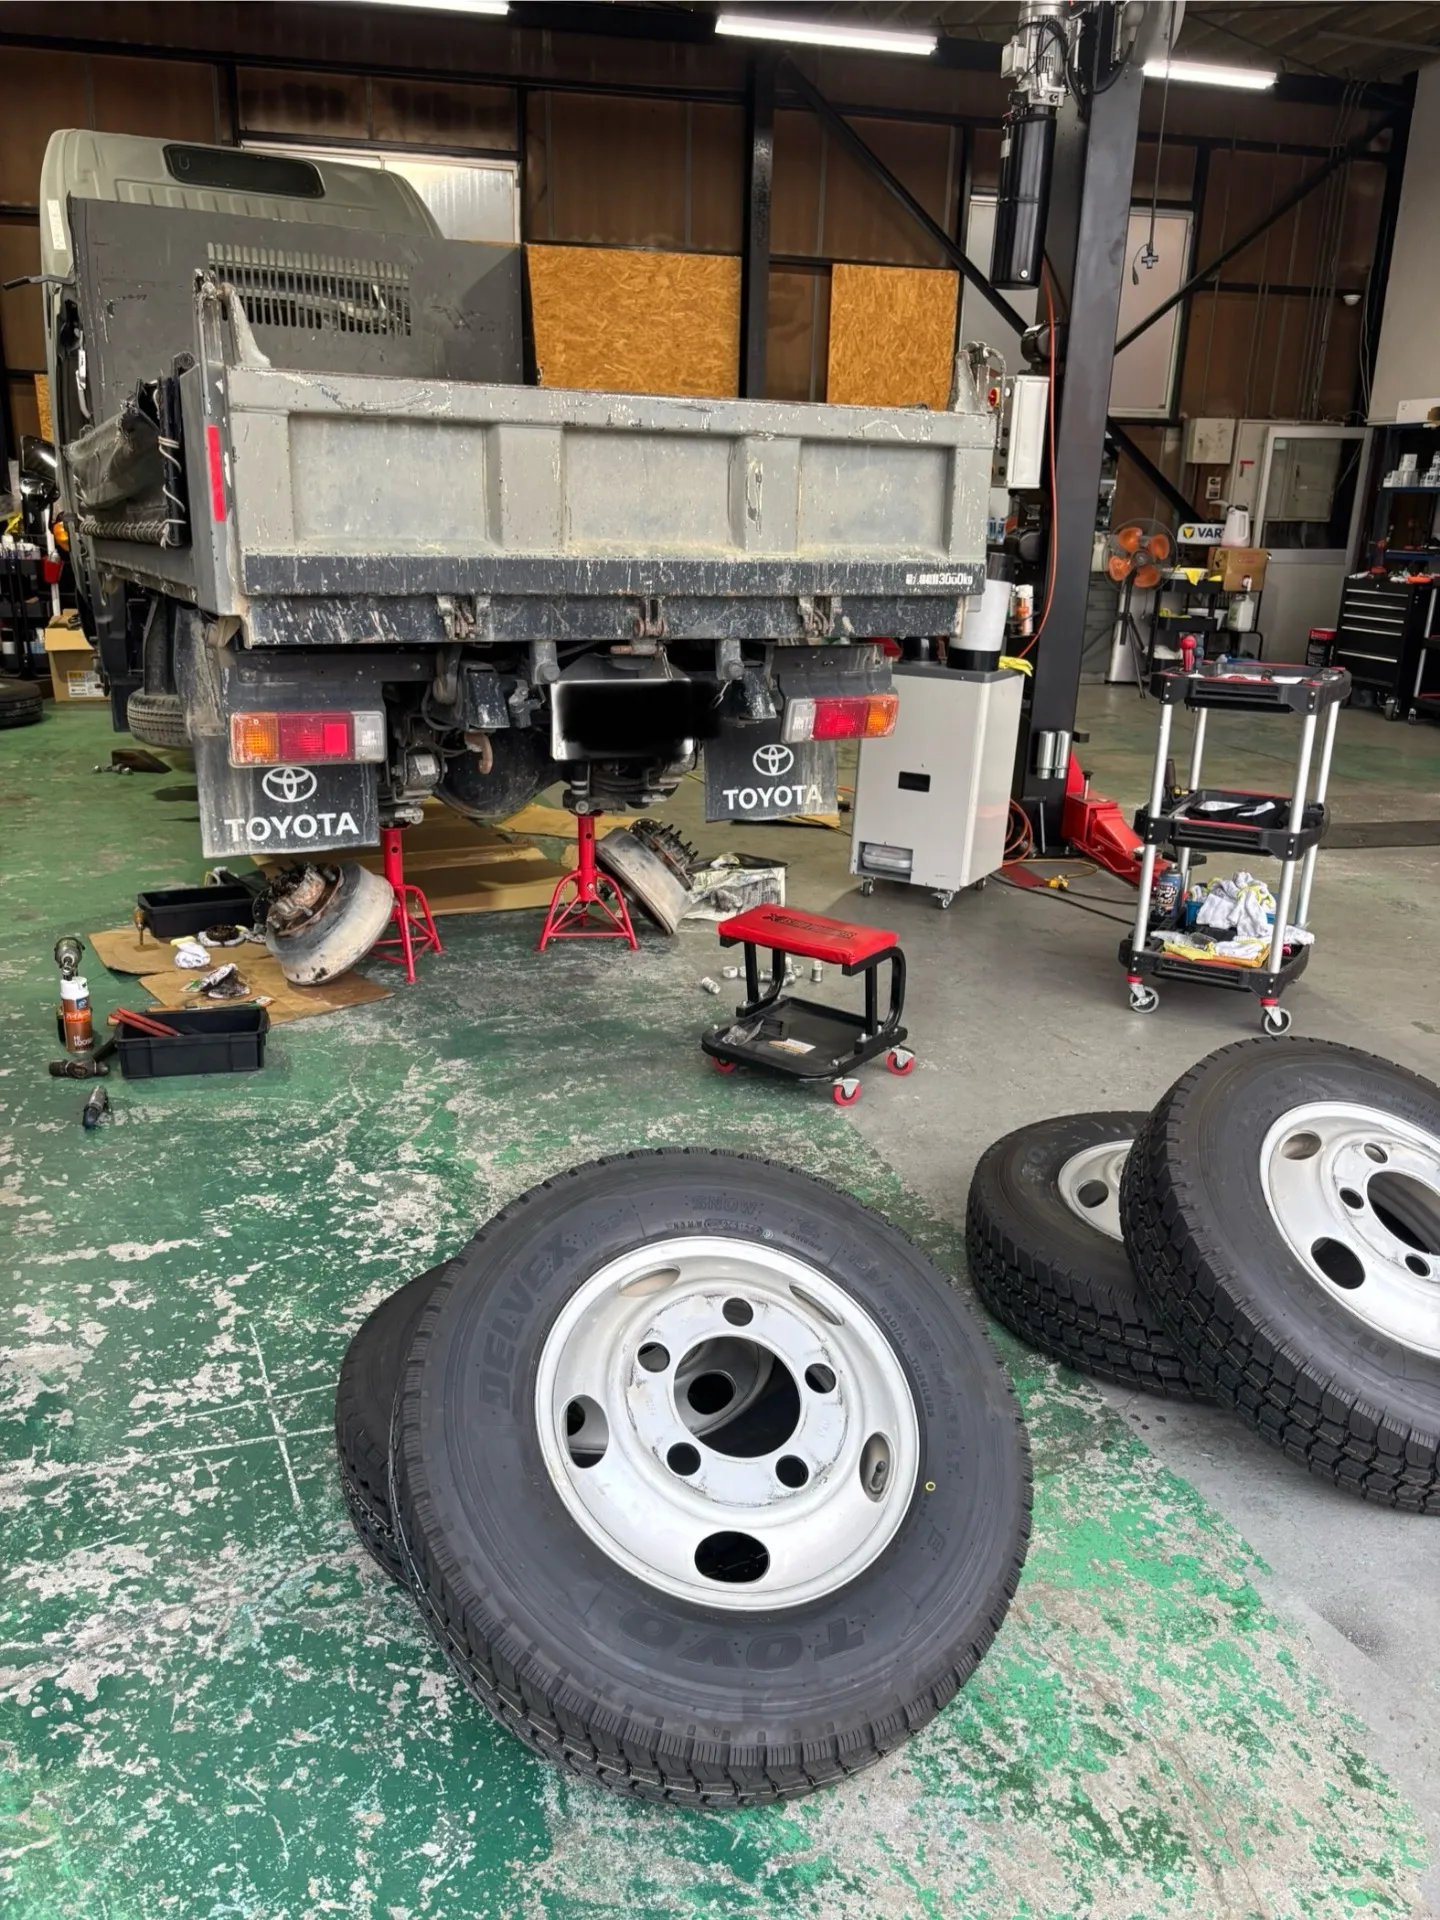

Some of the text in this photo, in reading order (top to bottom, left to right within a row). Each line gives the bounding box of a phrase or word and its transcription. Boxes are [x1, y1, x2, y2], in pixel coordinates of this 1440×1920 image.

[1198, 527, 1224, 538] VAR
[723, 785, 823, 810] TOYOTA
[224, 812, 359, 842] TOYOTA
[691, 1194, 758, 1216] SNOW
[479, 1232, 580, 1410] DELVEX
[878, 1306, 907, 1347] RADIAL
[619, 1608, 865, 1672] TOYO
